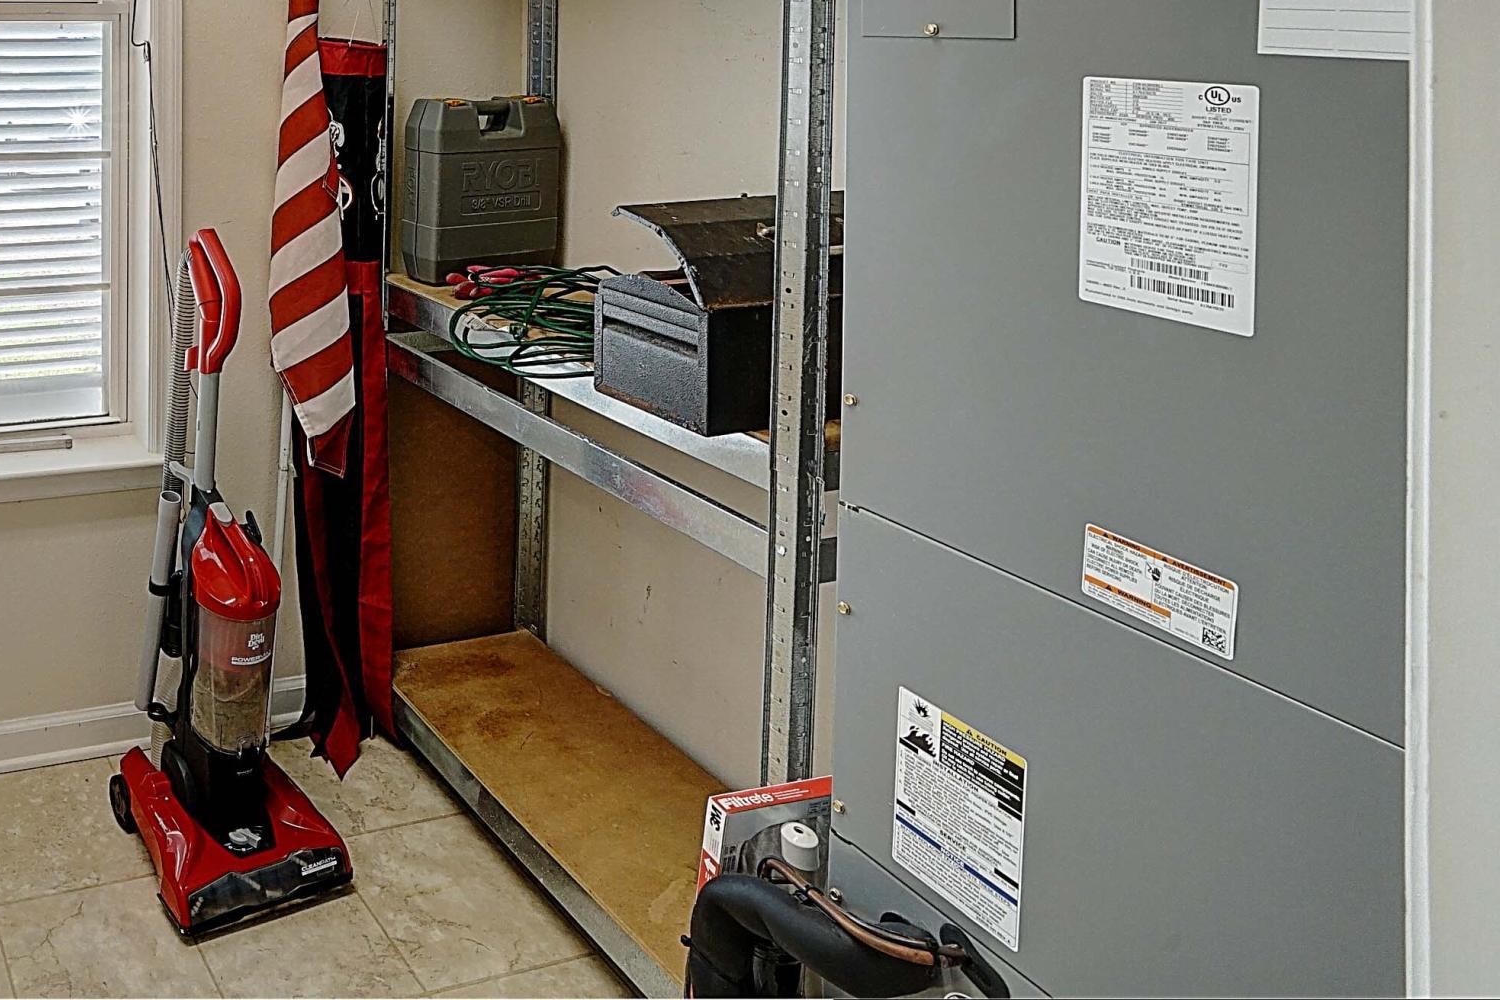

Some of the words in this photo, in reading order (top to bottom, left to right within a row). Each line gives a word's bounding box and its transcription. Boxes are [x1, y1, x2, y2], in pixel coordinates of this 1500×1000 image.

[1205, 106, 1232, 114] LISTED
[460, 159, 541, 192] RYOBI
[514, 194, 531, 207] Drill
[1096, 237, 1121, 246] CAUTION
[1117, 588, 1152, 609] WARNING
[976, 733, 1006, 757] CAUTION
[932, 758, 978, 793] INSTALLATION
[717, 792, 774, 810] Filtrete
[709, 804, 722, 832] 3M
[939, 829, 966, 852] SERVICE
